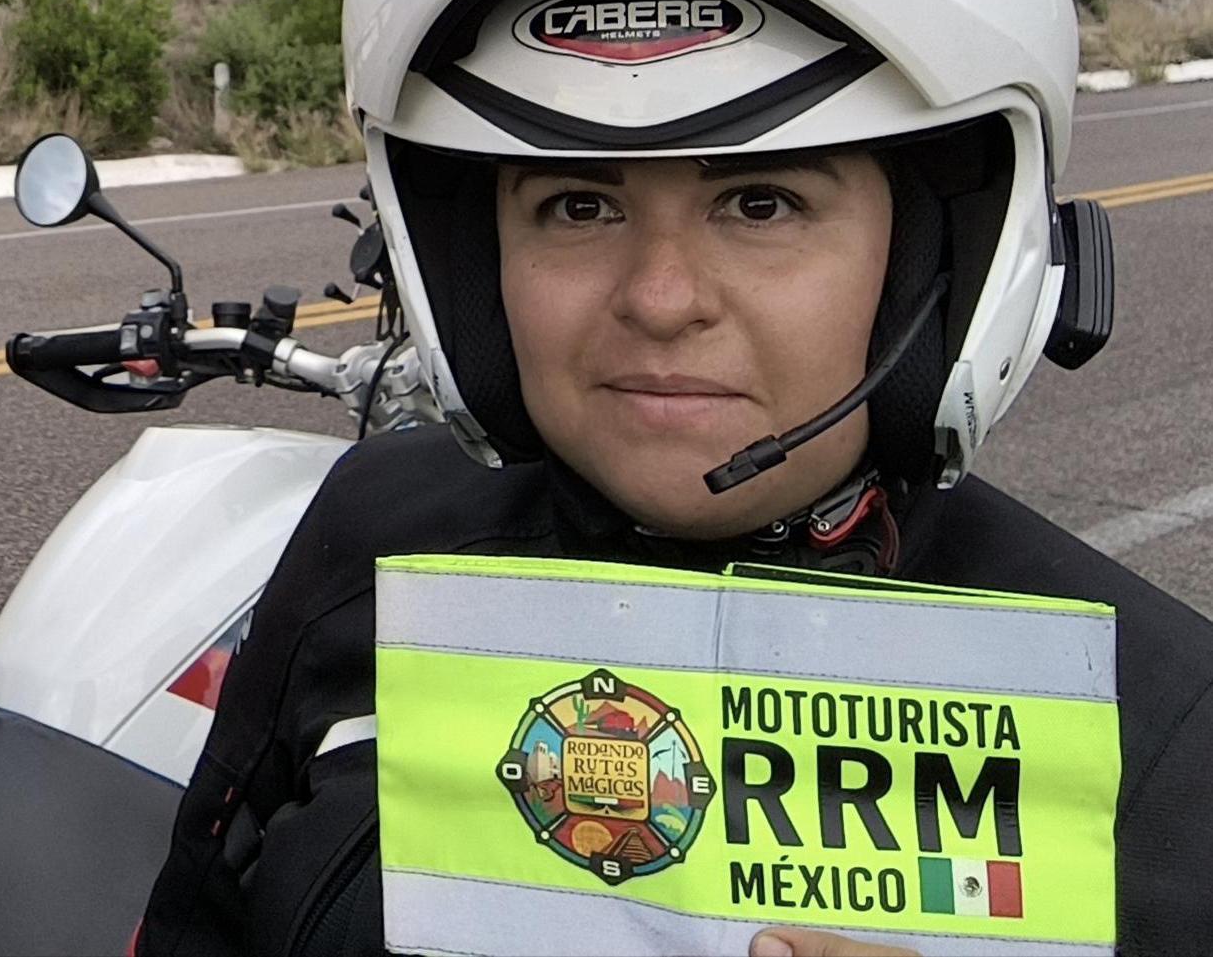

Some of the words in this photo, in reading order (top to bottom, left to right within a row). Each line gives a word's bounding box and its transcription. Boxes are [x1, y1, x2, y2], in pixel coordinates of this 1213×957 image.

[544, 0, 723, 35] CABERG
[600, 29, 661, 40] HELMETS
[721, 685, 1021, 751] MOTOTURISTA
[721, 736, 1023, 857] RRM
[730, 855, 907, 913] MÉXICO
